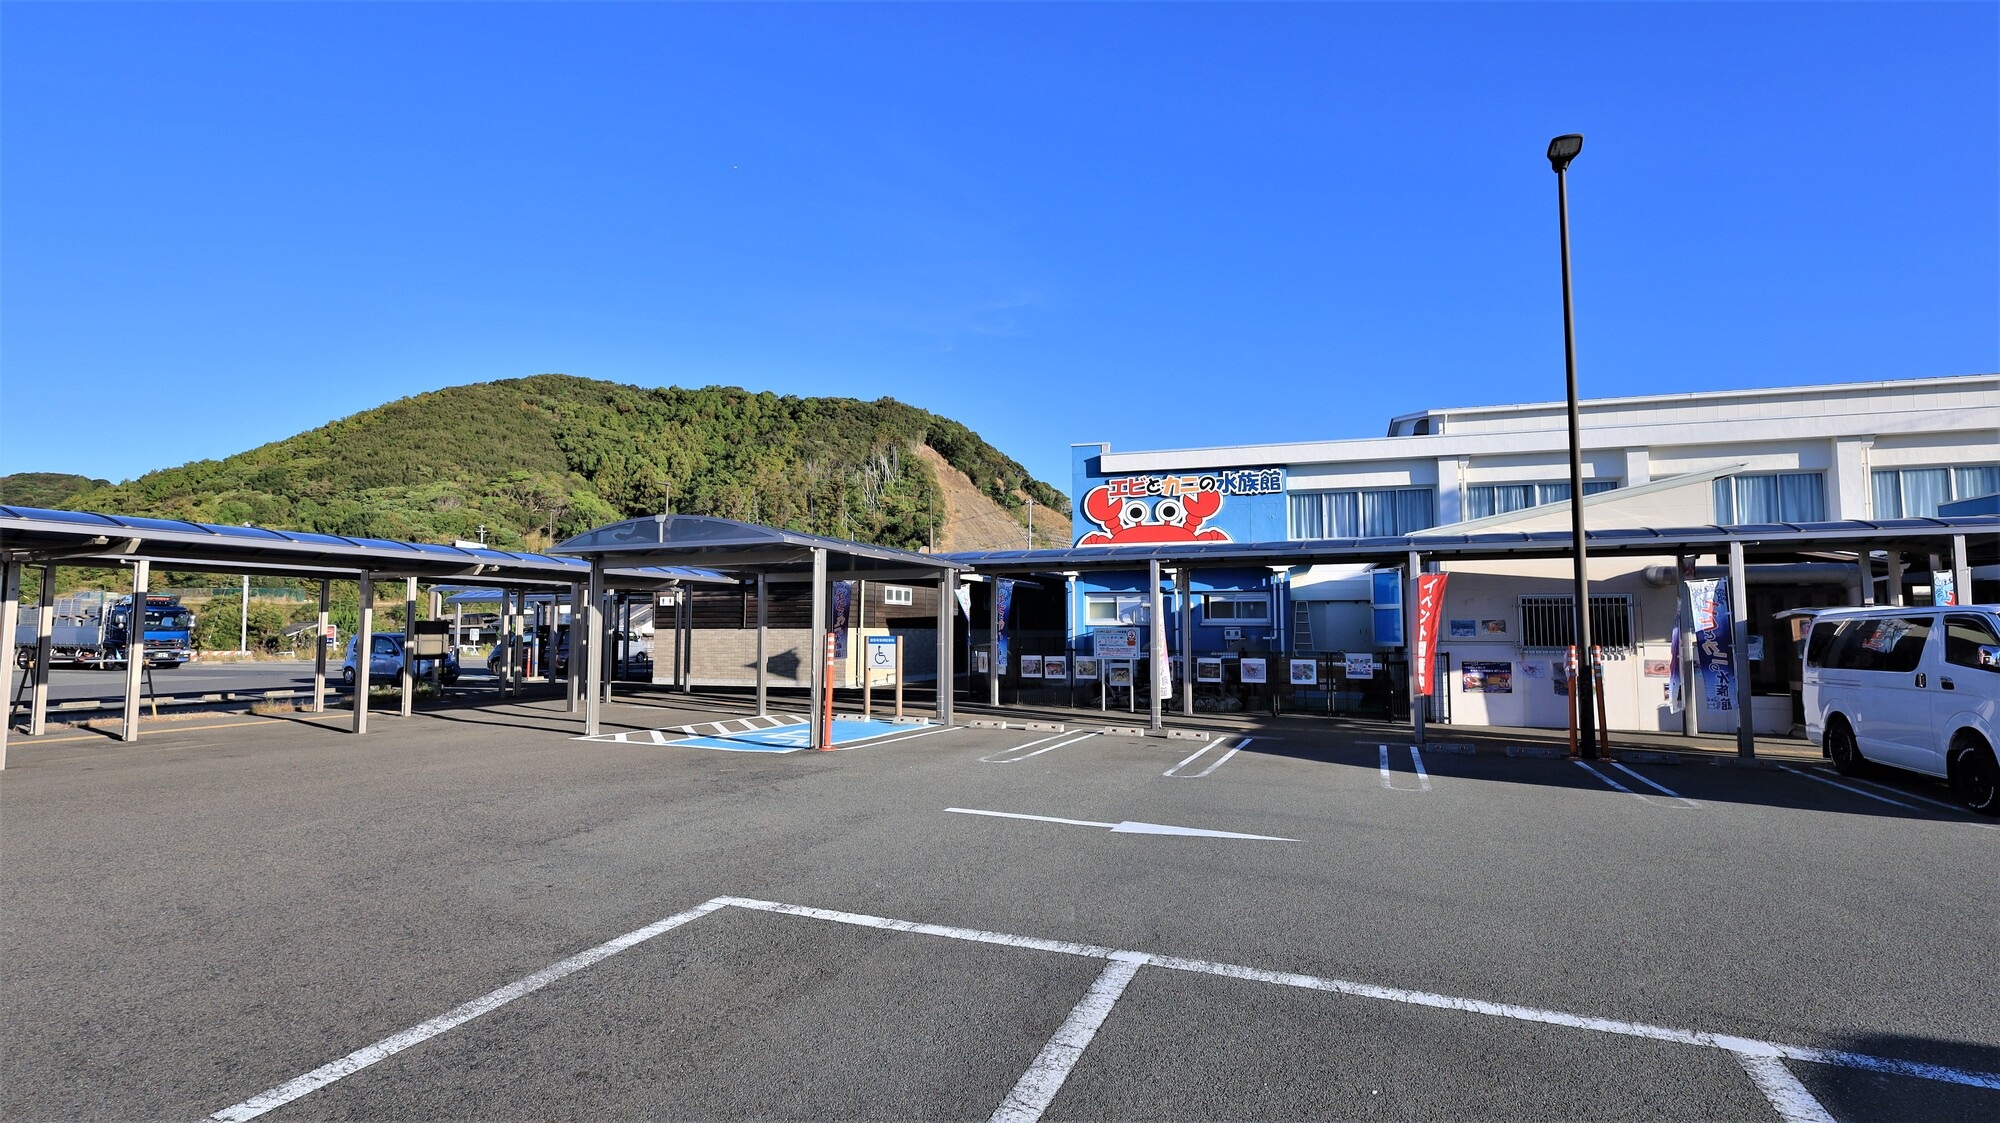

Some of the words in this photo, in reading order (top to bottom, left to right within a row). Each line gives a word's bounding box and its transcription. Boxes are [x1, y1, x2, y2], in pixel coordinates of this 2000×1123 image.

[1109, 471, 1282, 497] エビとカニの水族館
